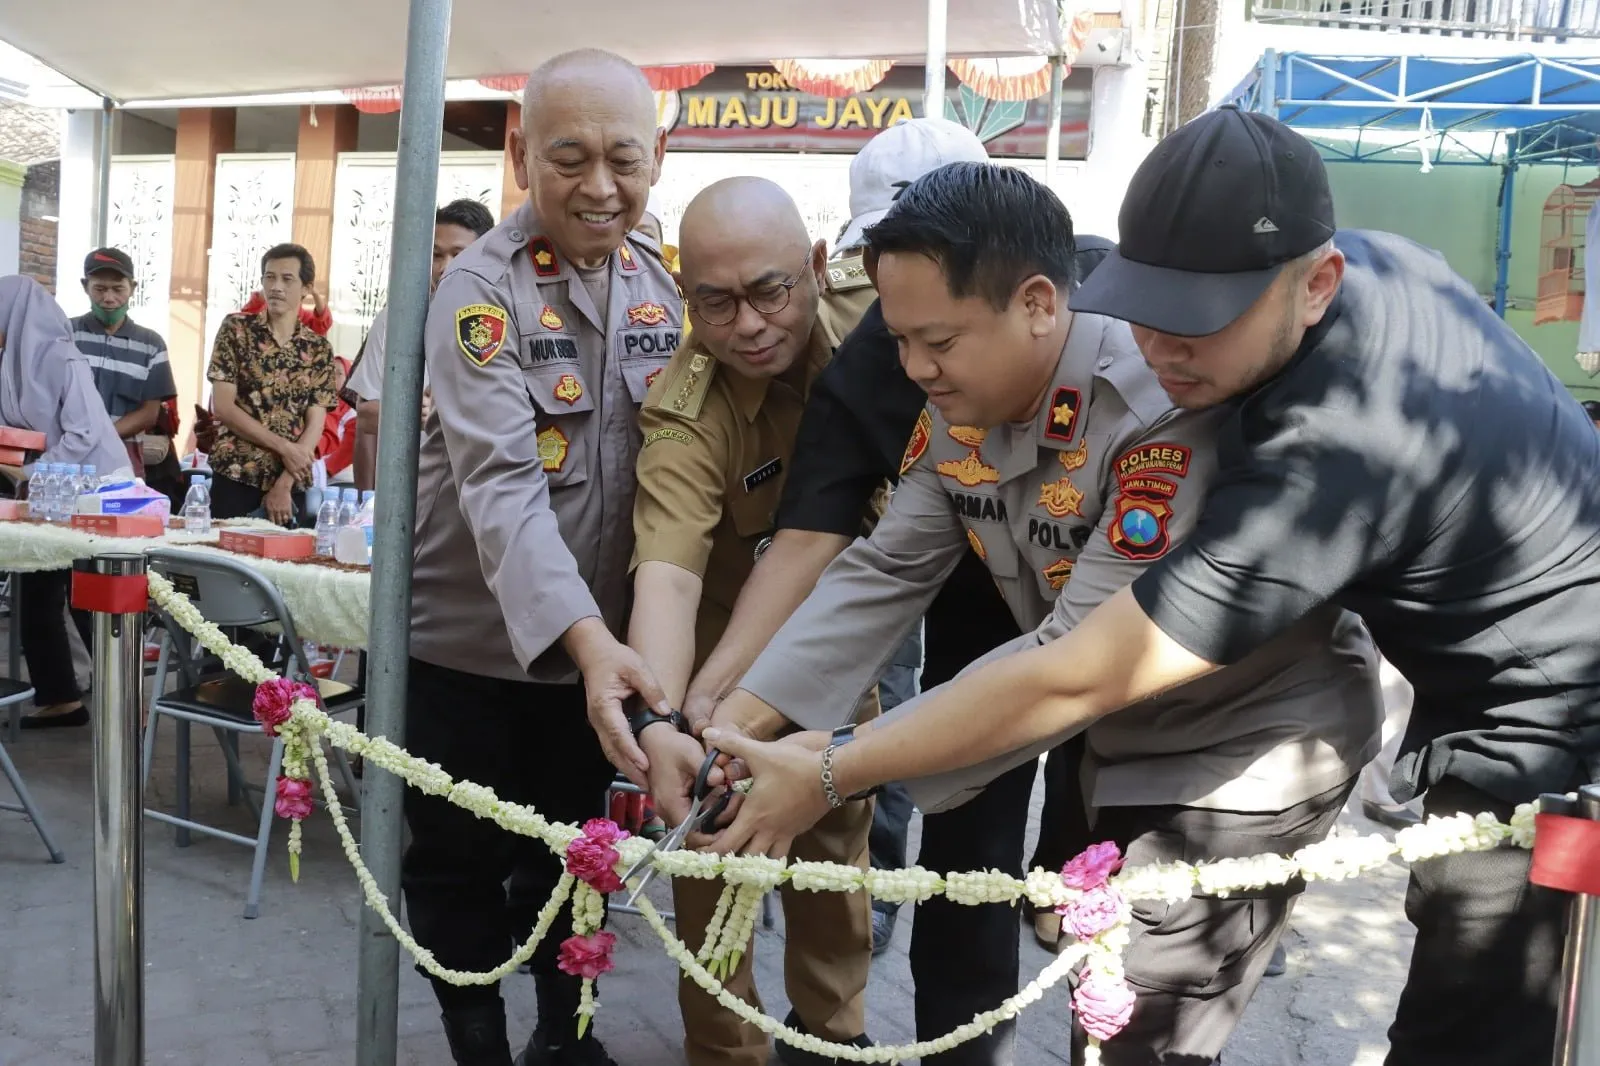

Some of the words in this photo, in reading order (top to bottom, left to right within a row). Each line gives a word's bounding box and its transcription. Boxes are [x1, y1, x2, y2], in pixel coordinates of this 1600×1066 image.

[746, 72, 798, 90] TOK
[687, 96, 798, 128] MAJU
[815, 96, 914, 129] JAYA
[529, 338, 557, 362] NUR
[625, 331, 680, 354] POLRI
[1120, 448, 1183, 471] POLRES
[1124, 480, 1145, 489] JAWA
[1146, 480, 1172, 493] TIMUR
[1028, 518, 1092, 550] POLR
